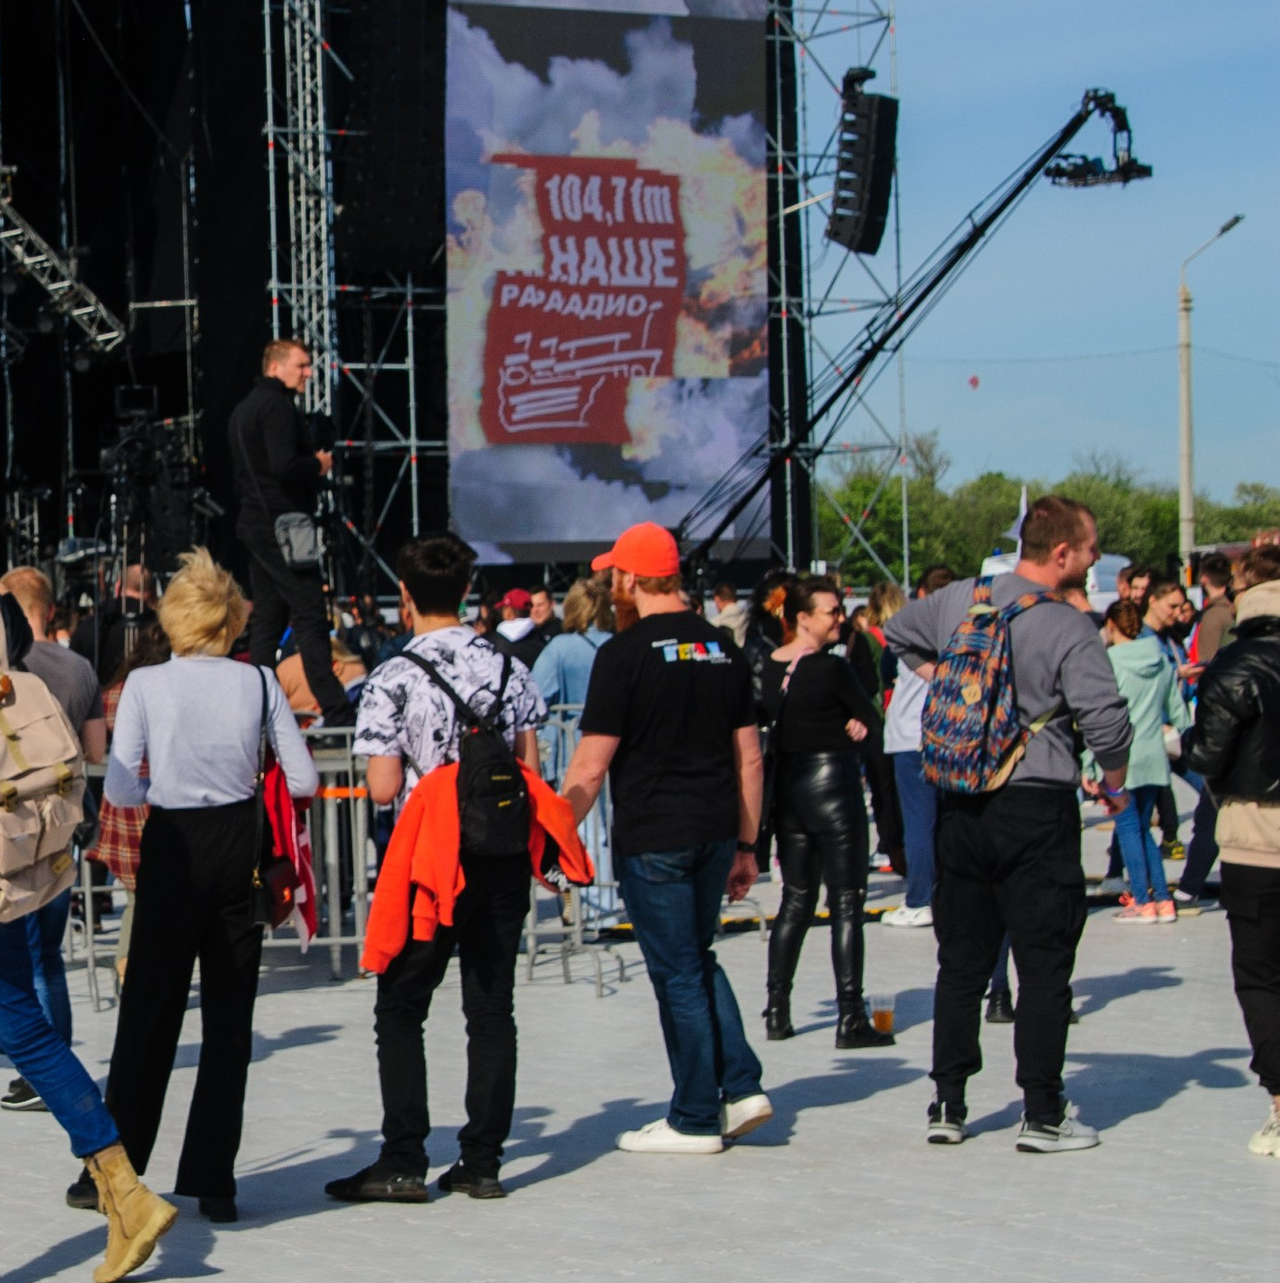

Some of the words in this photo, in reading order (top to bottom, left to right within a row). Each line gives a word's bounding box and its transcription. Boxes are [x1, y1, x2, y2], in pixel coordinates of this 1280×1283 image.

[544, 173, 627, 227] 104,7
[630, 176, 675, 225] fm
[548, 235, 679, 288] НАШЕ
